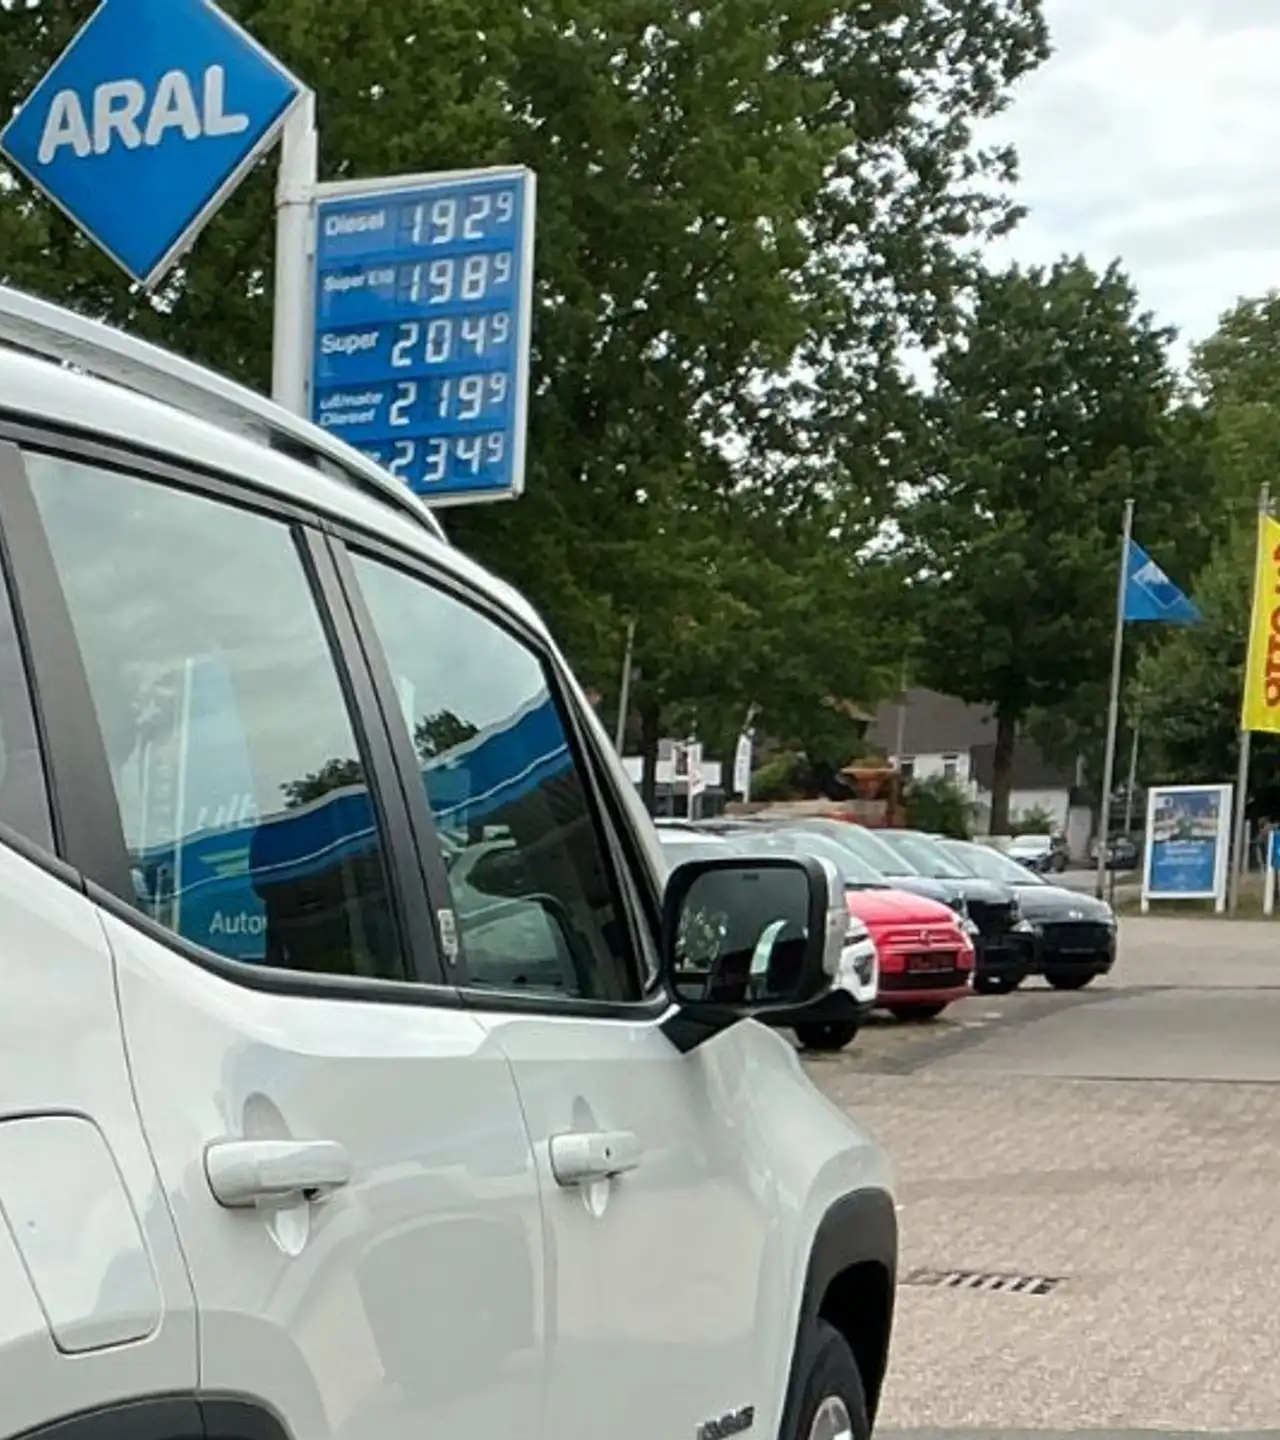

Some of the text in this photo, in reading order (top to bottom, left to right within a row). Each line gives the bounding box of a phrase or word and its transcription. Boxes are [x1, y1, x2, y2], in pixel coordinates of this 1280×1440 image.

[37, 64, 250, 165] ARAL
[325, 211, 385, 236] Diesel
[320, 312, 510, 368] Super 2049
[208, 908, 269, 936] Auto
